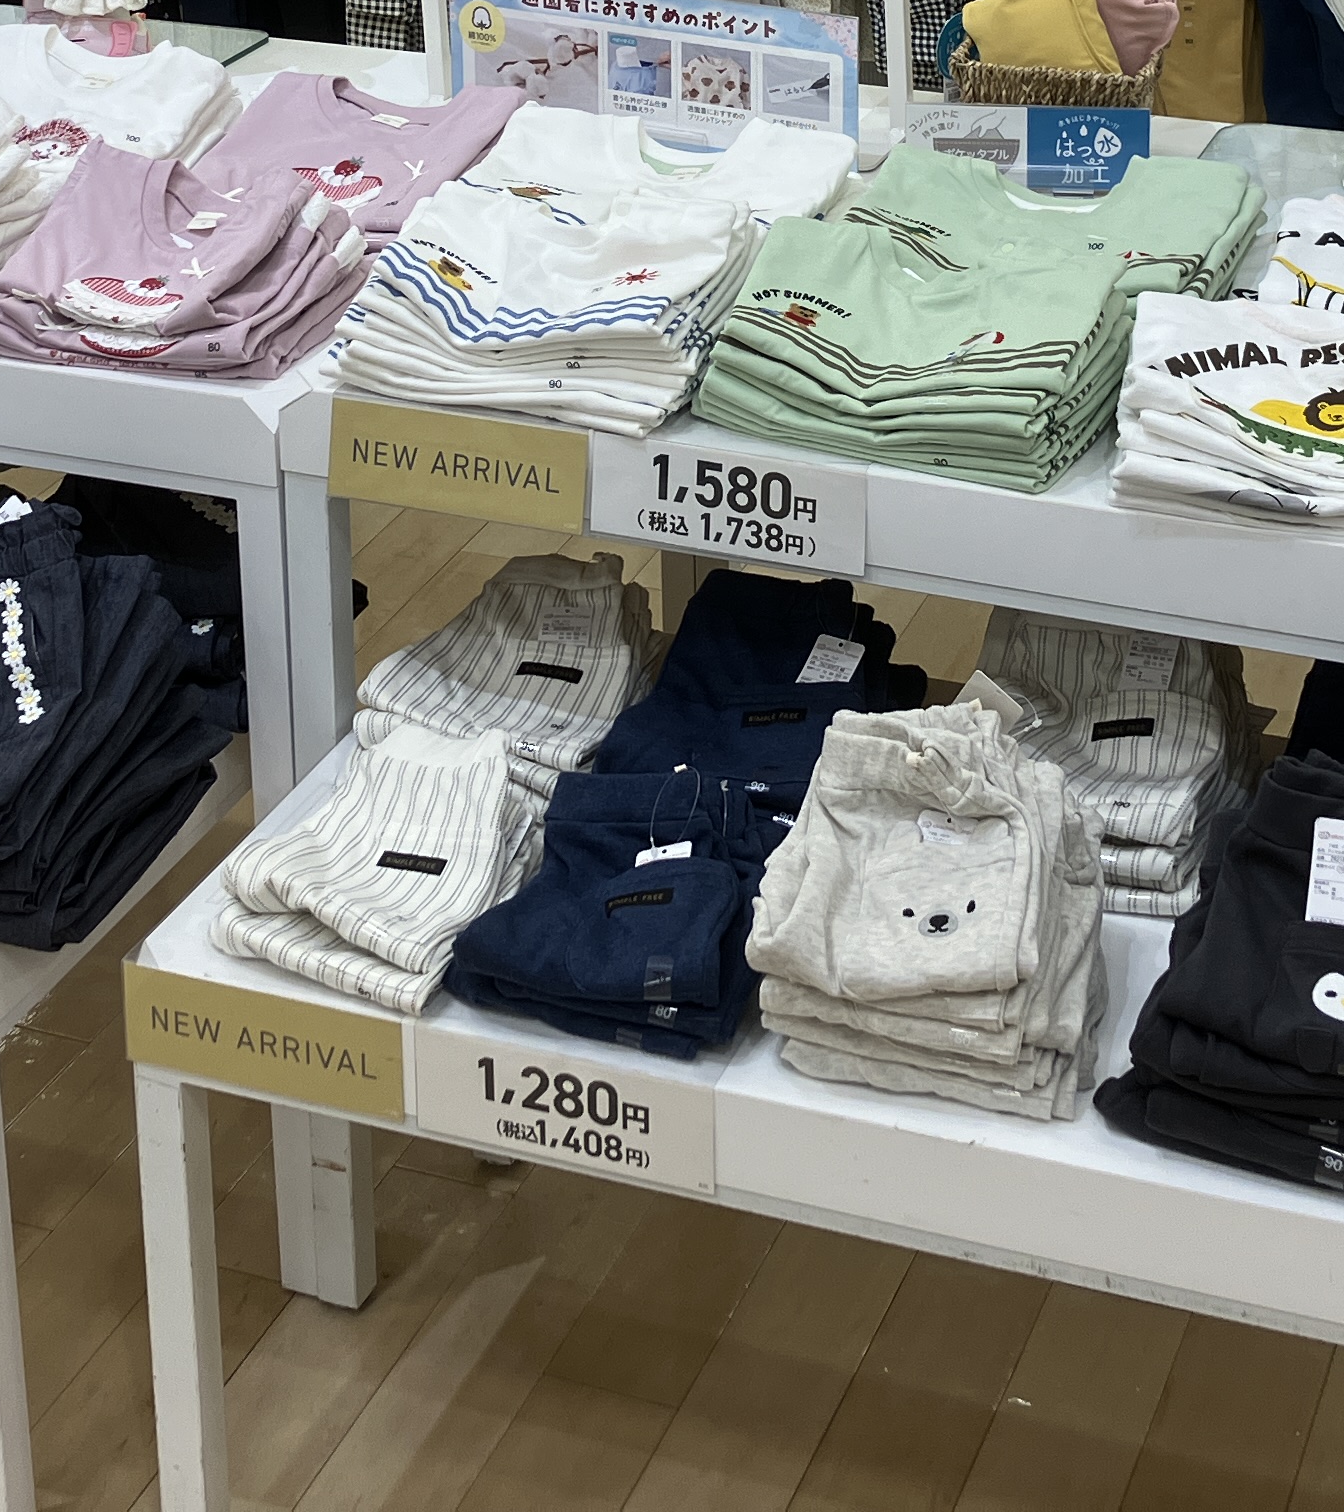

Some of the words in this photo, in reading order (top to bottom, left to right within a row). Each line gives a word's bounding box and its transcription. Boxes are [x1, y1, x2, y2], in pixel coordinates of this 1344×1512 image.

[687, 105, 746, 120] 通園着におすすめの
[687, 114, 733, 127] プリントTシャツ
[908, 109, 959, 132] コンパクトに
[125, 134, 141, 143] 100
[921, 122, 961, 139] 持ち運び!
[1061, 163, 1110, 185] 加工
[1086, 241, 1104, 251] 100
[751, 288, 781, 303] HOT
[783, 290, 853, 320] SUMMER!
[207, 342, 221, 353] 80
[1148, 340, 1288, 379] NIMAL
[548, 379, 563, 389] 90
[353, 437, 419, 472] NEW
[430, 450, 562, 495] ARRIVAL
[652, 452, 818, 524] 1,580円
[150, 1006, 225, 1044] NEW
[237, 1024, 378, 1082] ARRIVAL
[478, 1057, 651, 1134] 1,280円
